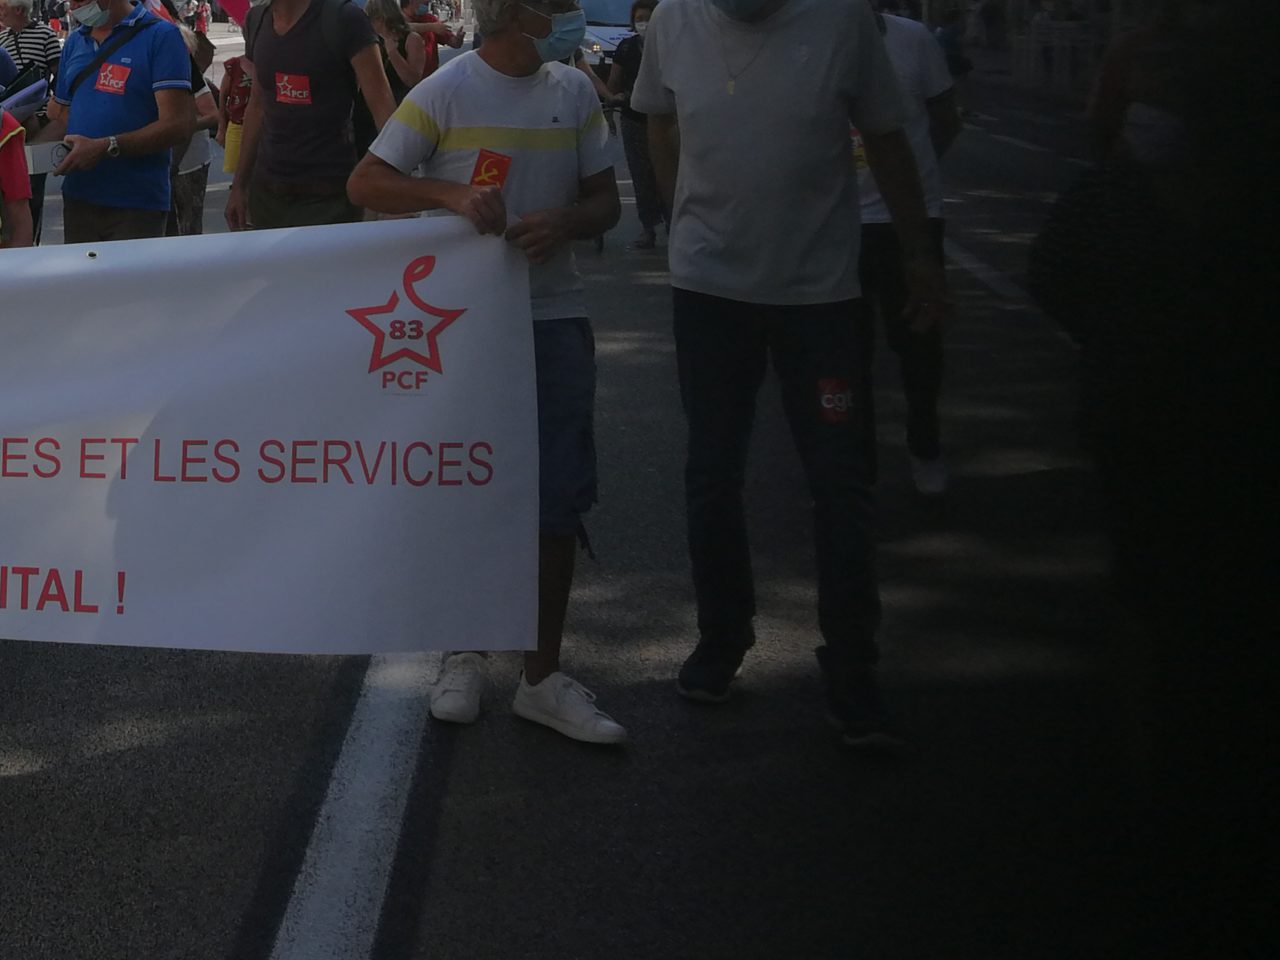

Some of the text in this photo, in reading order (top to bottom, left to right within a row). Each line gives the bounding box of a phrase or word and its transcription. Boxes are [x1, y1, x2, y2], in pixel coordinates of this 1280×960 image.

[291, 90, 309, 98] PCF
[388, 319, 424, 340] 83
[382, 370, 429, 390] PCF
[79, 437, 139, 480] ET
[153, 438, 241, 484] LES
[257, 438, 494, 488] SERVICES
[116, 571, 126, 615] !
